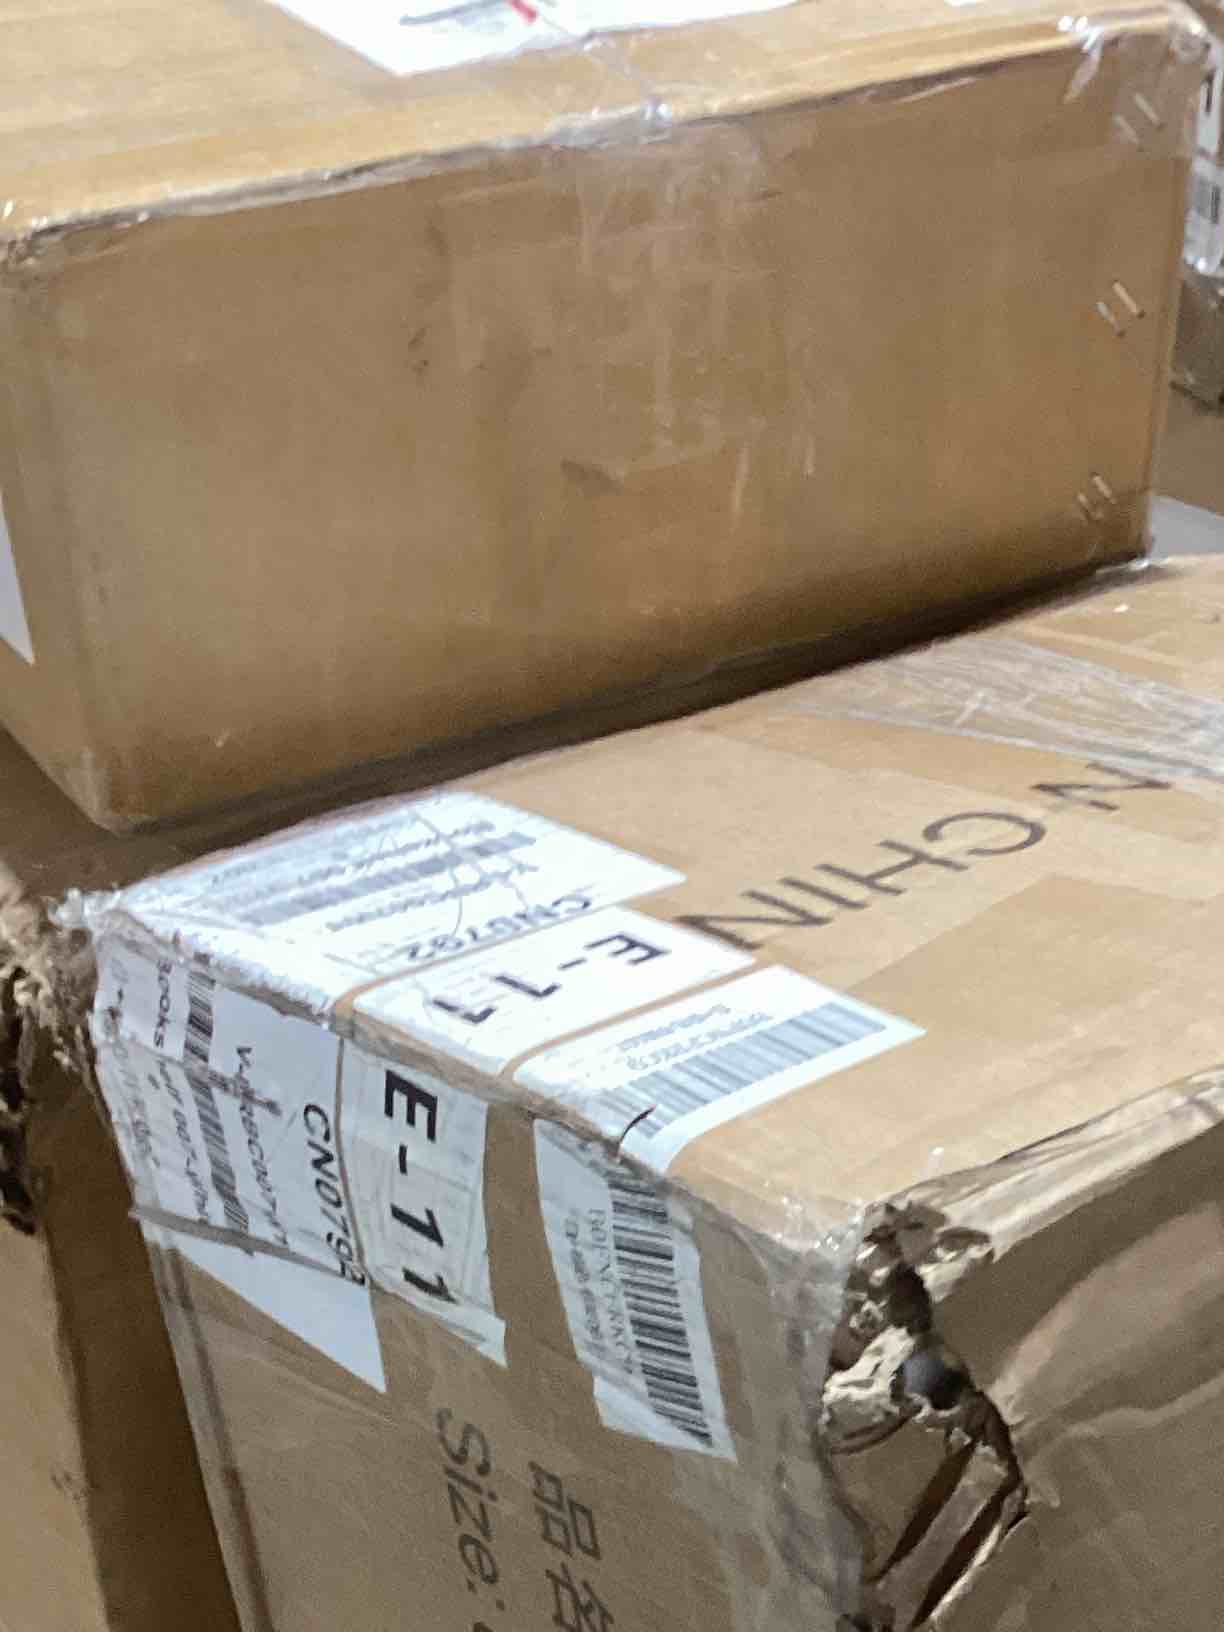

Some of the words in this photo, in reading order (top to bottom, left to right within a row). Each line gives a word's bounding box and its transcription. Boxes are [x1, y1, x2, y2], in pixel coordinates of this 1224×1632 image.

[431, 931, 668, 1024] E-11
[303, 1103, 366, 1287] CN0792
[384, 1069, 458, 1306] E-11
